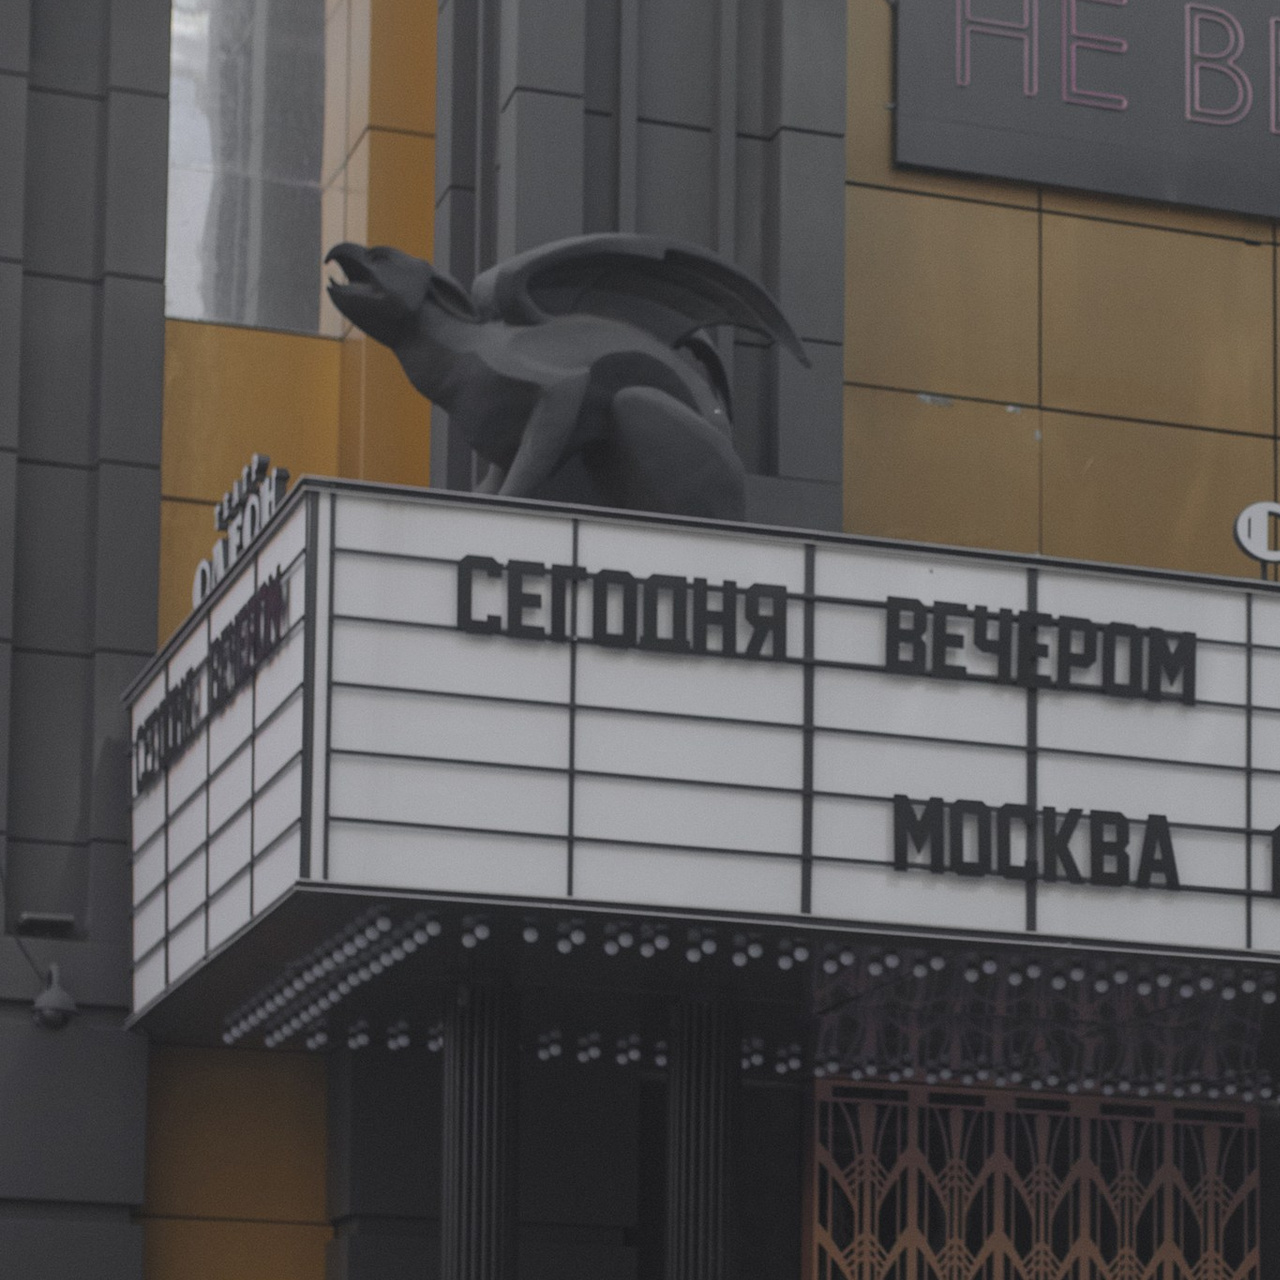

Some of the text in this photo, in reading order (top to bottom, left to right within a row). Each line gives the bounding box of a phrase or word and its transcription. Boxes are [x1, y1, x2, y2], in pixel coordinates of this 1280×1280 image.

[457, 554, 788, 662] СЕГОДНЯ
[885, 596, 1197, 706] ВЕЧЕРОМ
[893, 794, 1181, 892] МОСКВА
